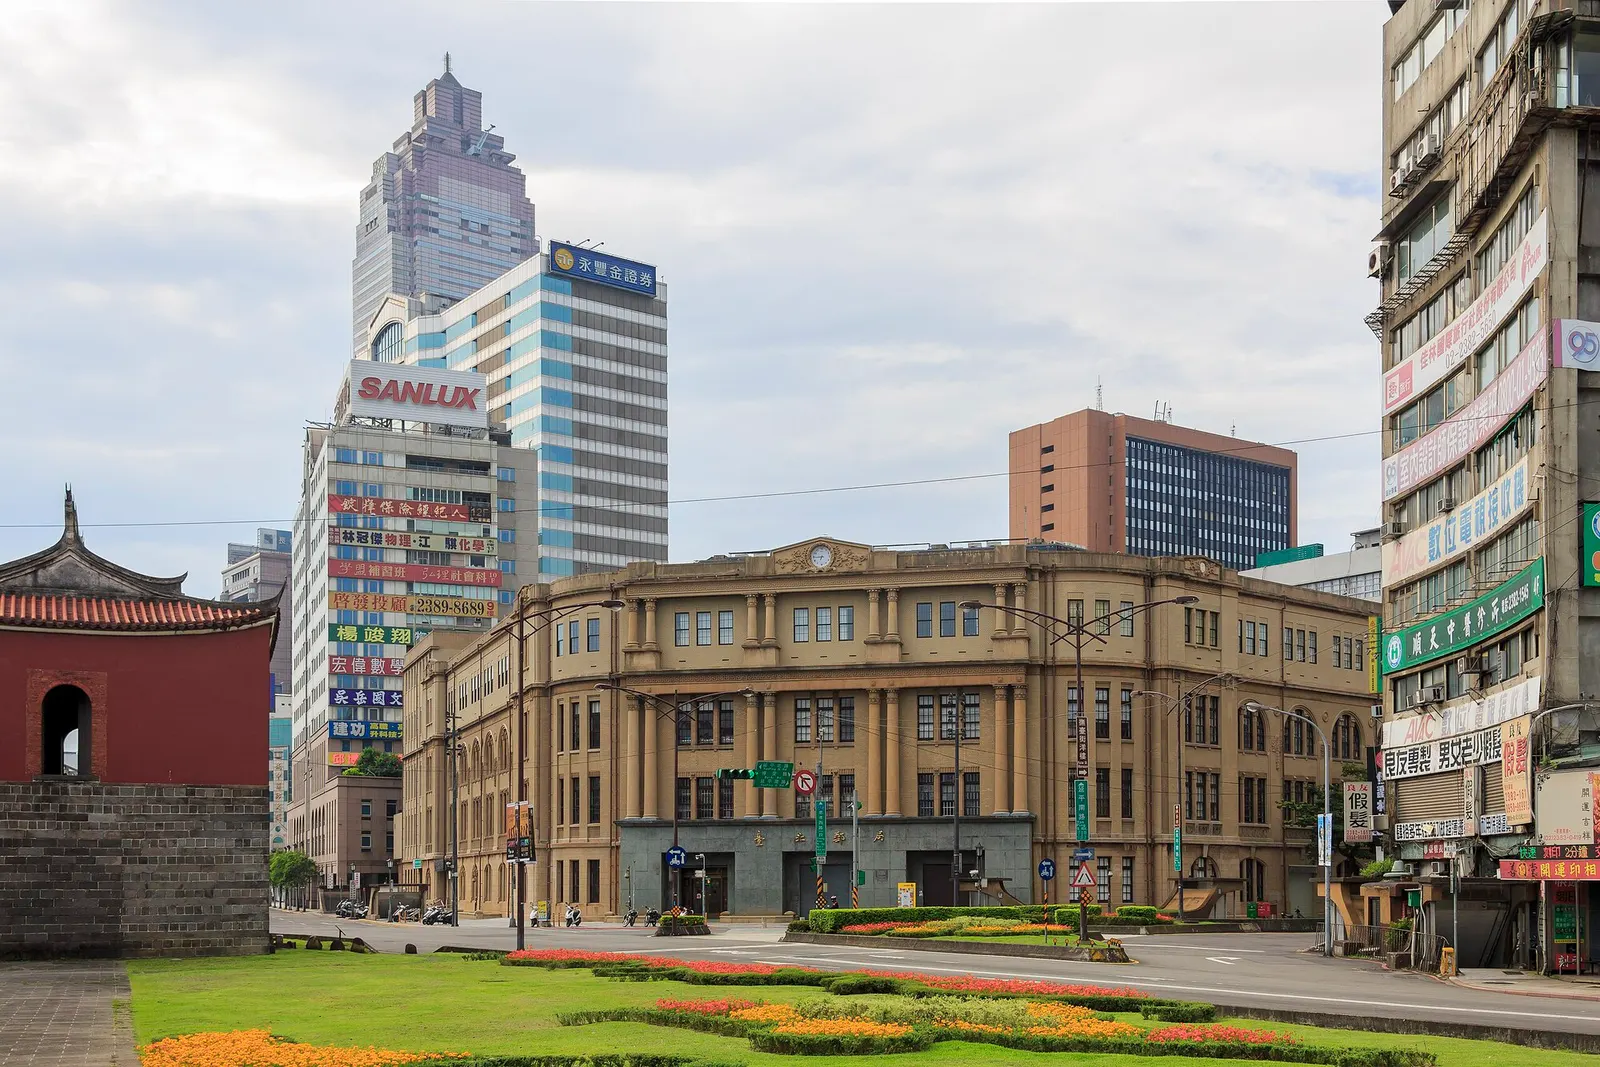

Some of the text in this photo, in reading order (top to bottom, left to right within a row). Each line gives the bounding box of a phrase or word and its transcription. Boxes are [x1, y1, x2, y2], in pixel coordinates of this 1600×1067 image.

[579, 256, 653, 288] 永豐金證券
[358, 377, 481, 410] SANLUX
[1428, 464, 1524, 562] 數位電視接收機
[417, 598, 485, 616] 2389-8689
[337, 625, 411, 644] 楊竣翔
[332, 657, 404, 675] 宏偉數學
[333, 721, 366, 737] 建功
[1509, 721, 1522, 738] 良友
[1385, 745, 1431, 777] 良友專製
[1504, 737, 1527, 777] 假髮
[1347, 784, 1368, 792] 良友
[1348, 792, 1368, 828] 假髮
[1519, 846, 1537, 859] 快速
[1543, 846, 1561, 859] 刻印
[1565, 845, 1589, 859] 2分鐘
